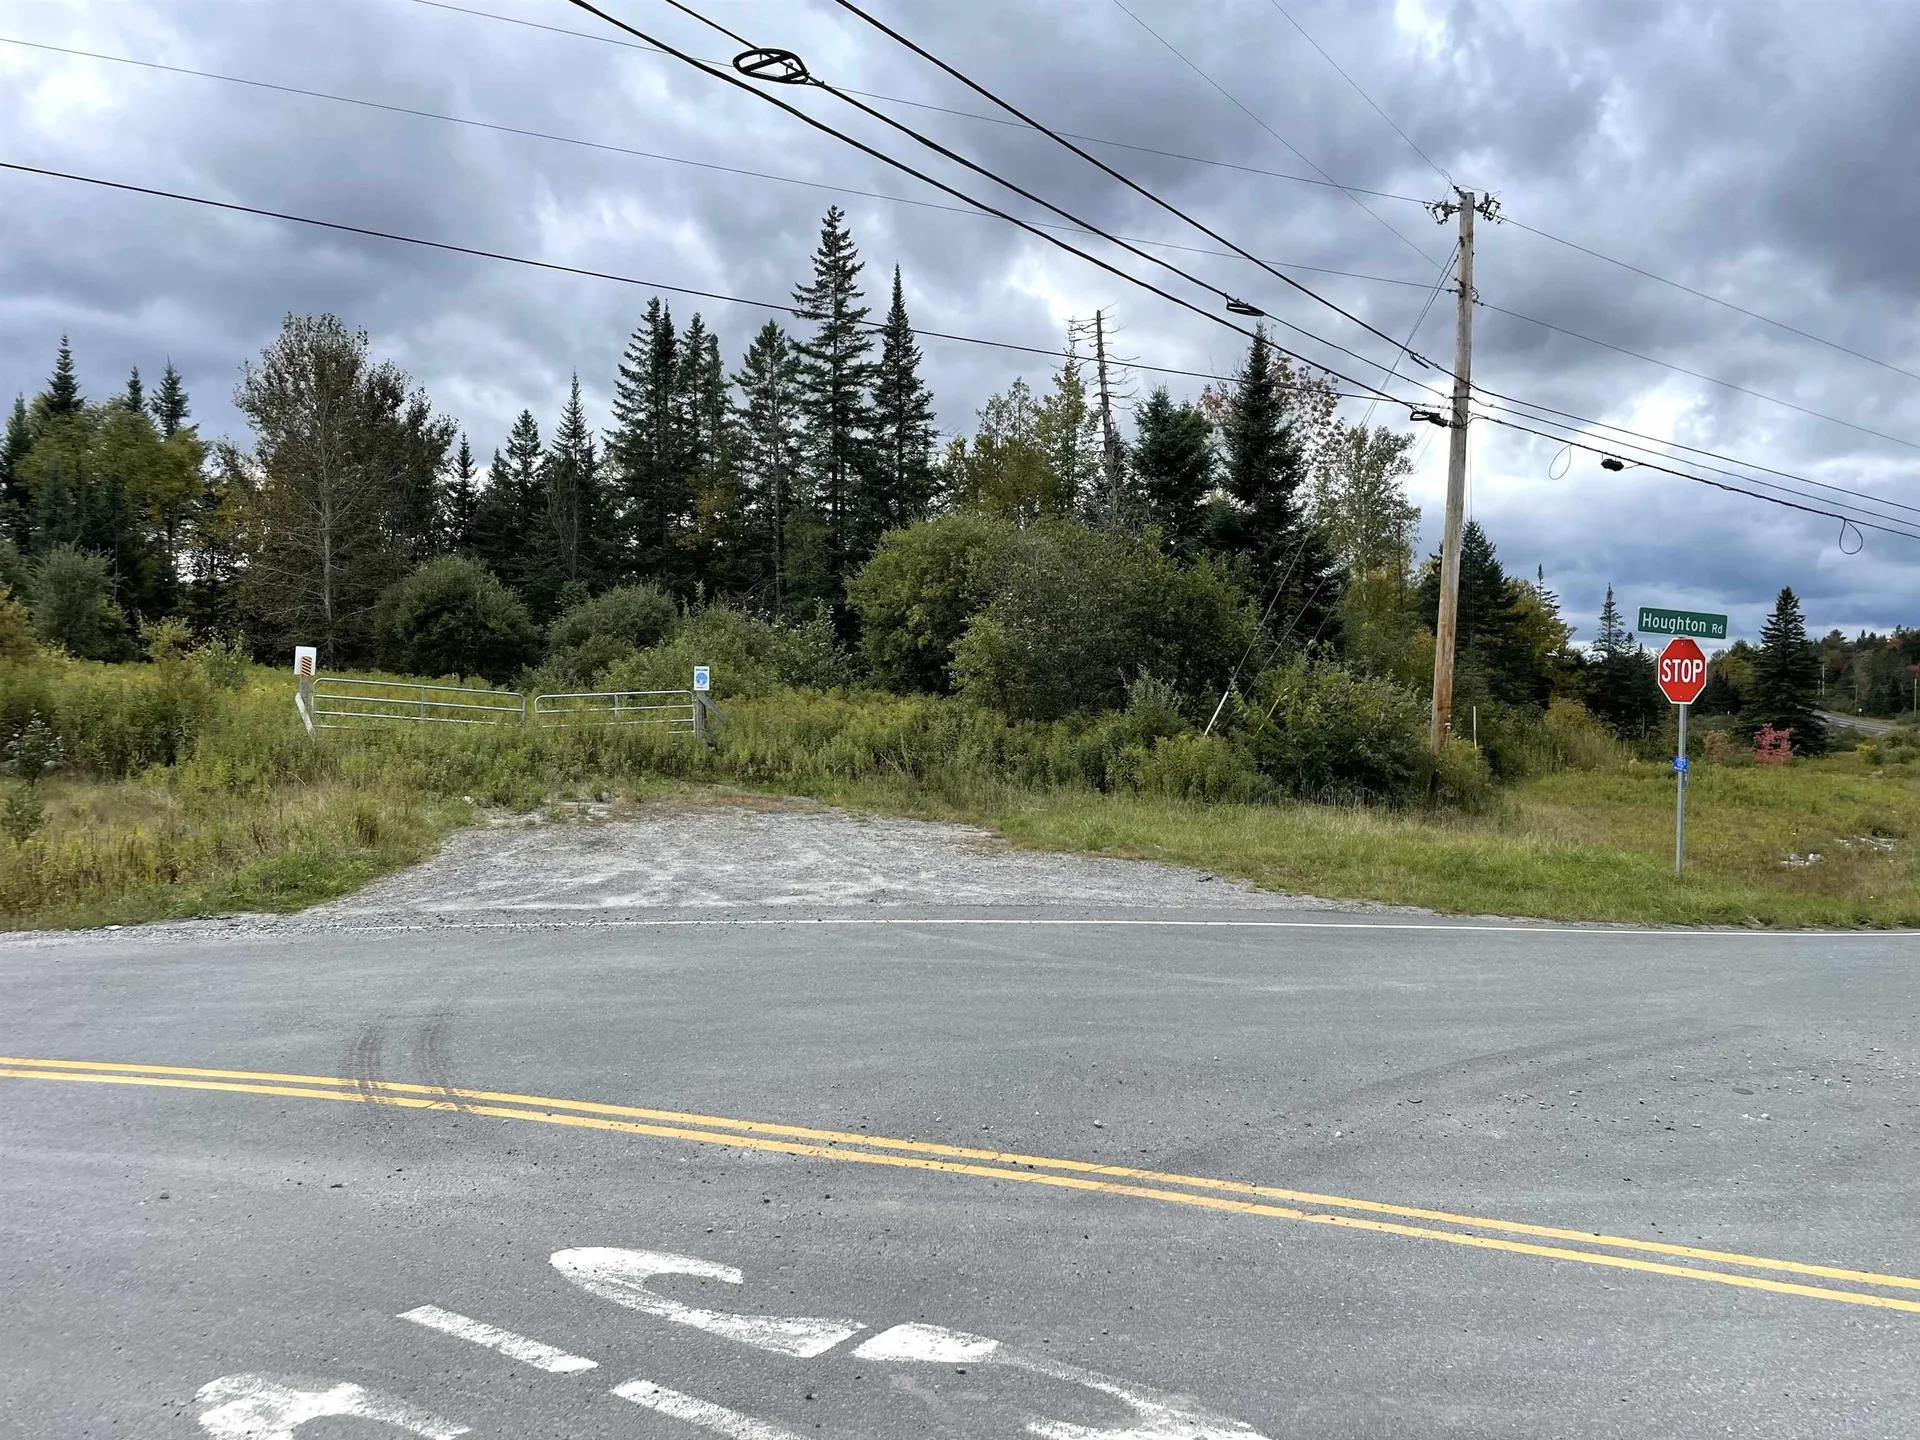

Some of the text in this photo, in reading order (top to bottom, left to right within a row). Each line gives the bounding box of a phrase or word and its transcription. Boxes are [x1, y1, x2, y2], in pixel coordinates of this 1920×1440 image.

[1642, 612, 1723, 634] Houghton Rd
[1661, 658, 1703, 683] STOP
